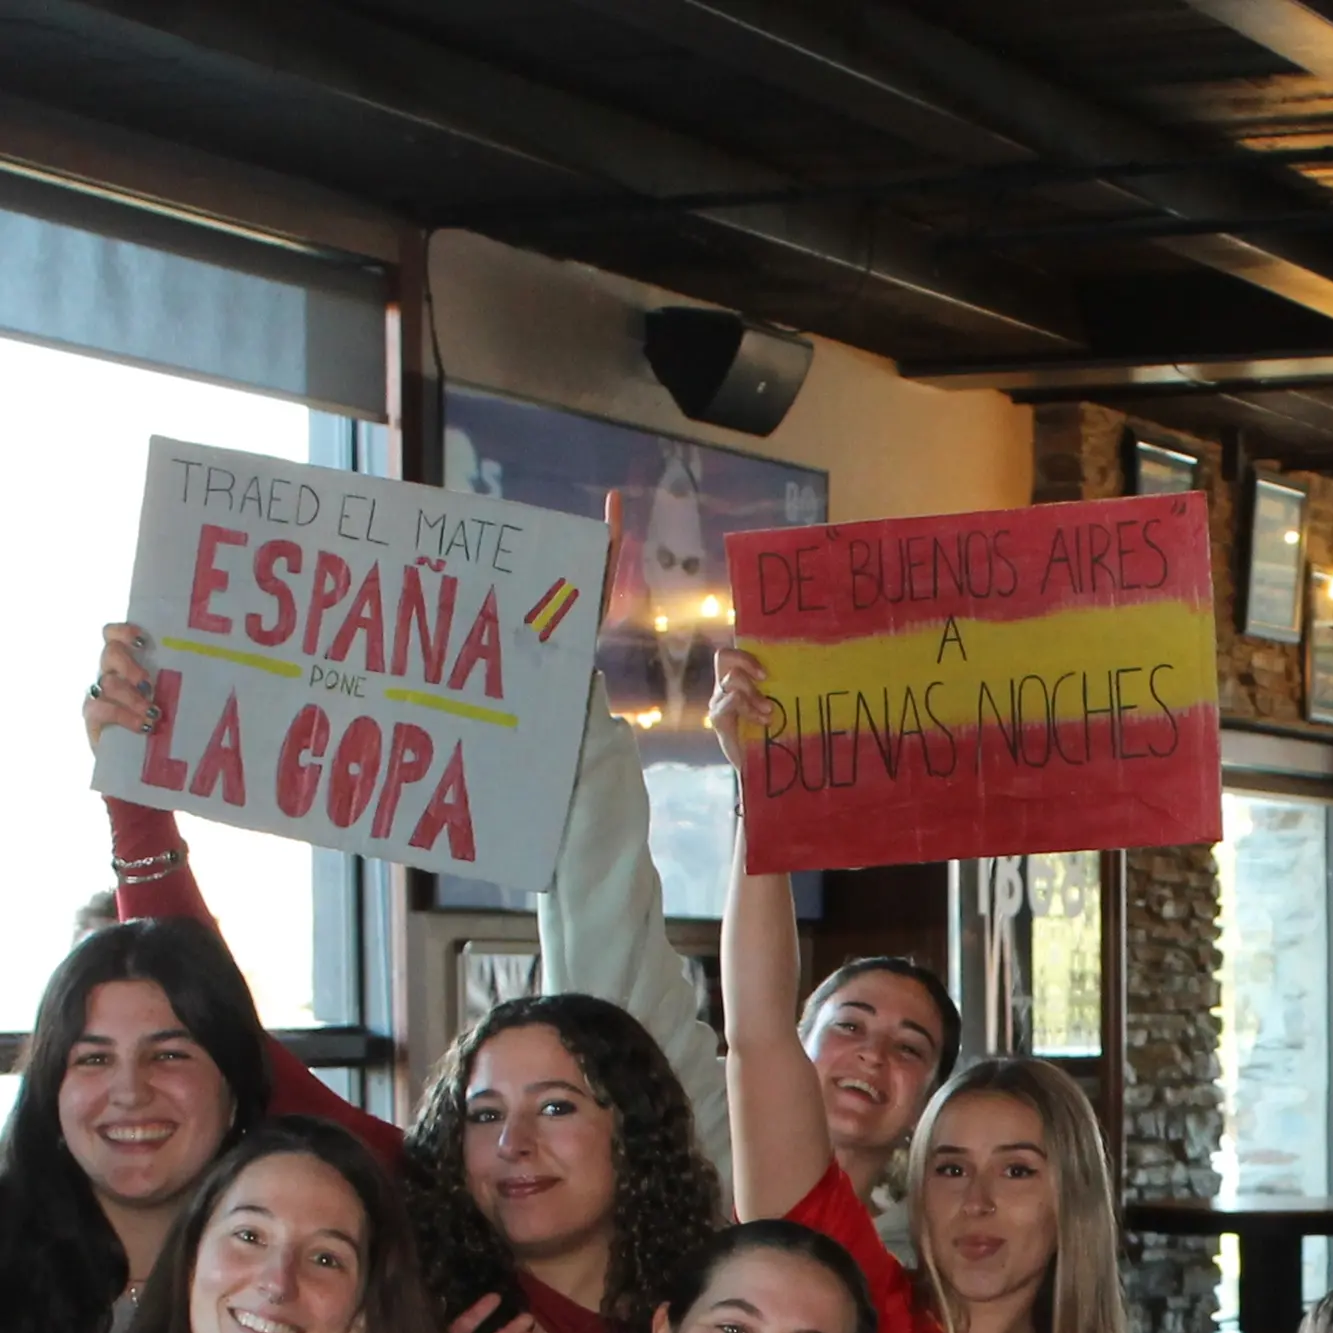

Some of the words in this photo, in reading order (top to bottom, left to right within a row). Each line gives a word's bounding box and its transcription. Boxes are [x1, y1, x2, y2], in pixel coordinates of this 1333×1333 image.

[171, 457, 321, 528] TRAED
[336, 493, 390, 547] EL
[414, 507, 525, 574] MATE
[187, 522, 505, 700] ESPAÑA
[757, 545, 828, 616] DE
[936, 614, 968, 664] A
[309, 664, 368, 699] PONE
[764, 681, 958, 799] BUENAS
[974, 663, 1179, 776] NOCHES
[140, 667, 247, 808] LA
[275, 703, 477, 863] COPA
